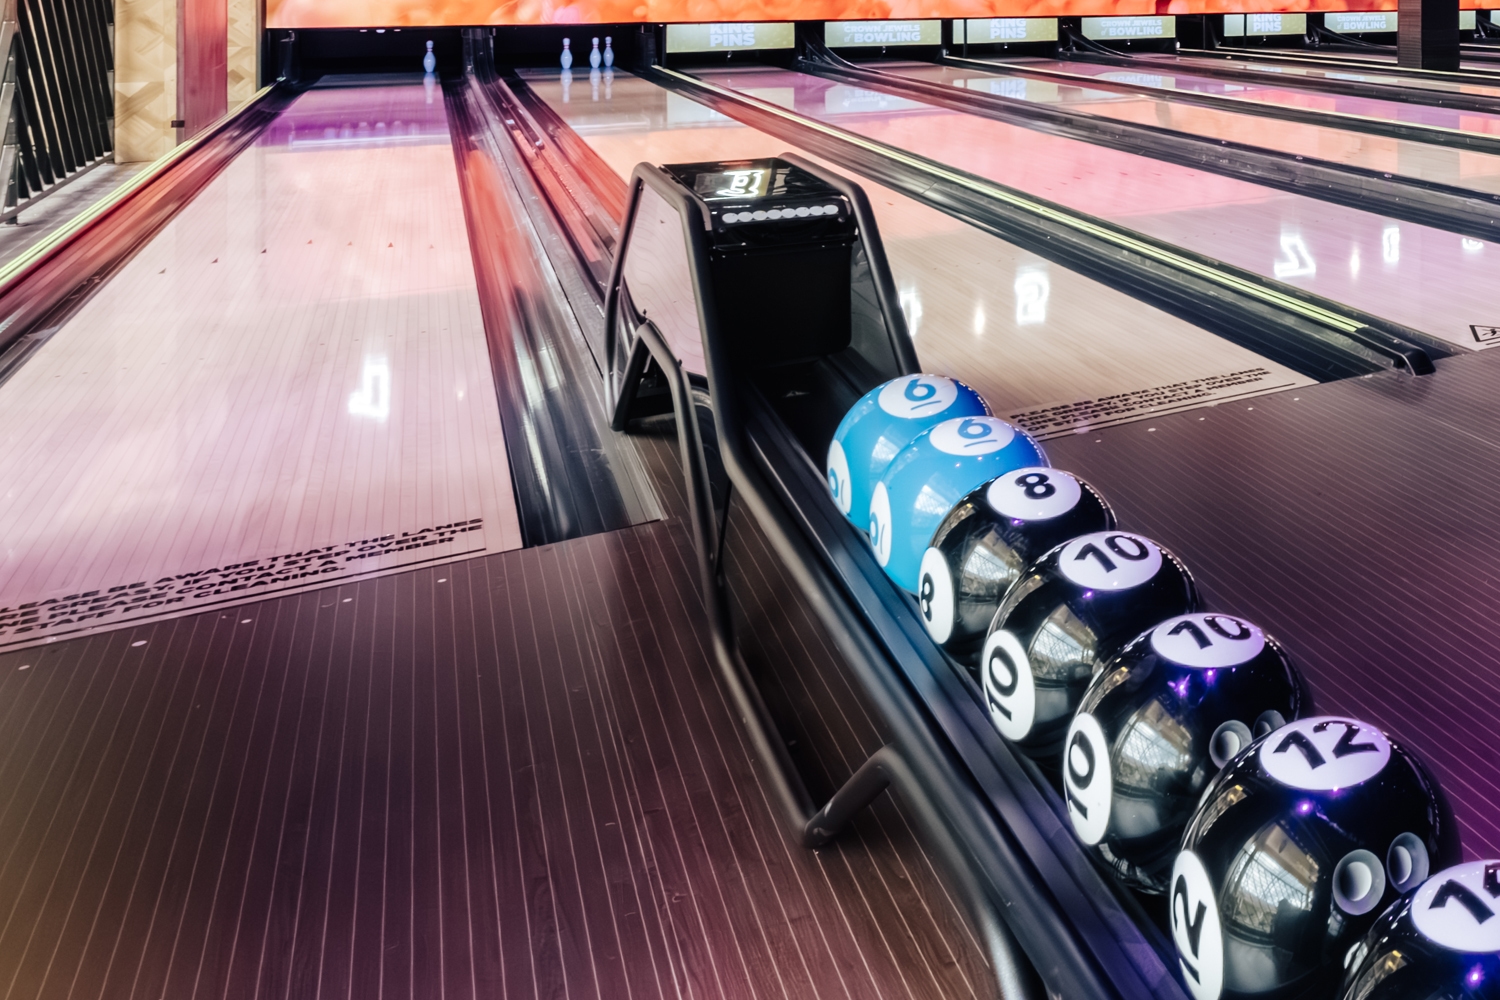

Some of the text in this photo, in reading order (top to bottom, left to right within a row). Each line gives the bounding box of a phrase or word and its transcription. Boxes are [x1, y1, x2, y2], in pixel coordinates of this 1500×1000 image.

[710, 24, 755, 35] KING
[844, 24, 921, 33] CROWN JEWELS
[990, 18, 1026, 28] KING
[990, 27, 1026, 39] PINS
[1101, 19, 1129, 27] CROWN
[1109, 26, 1163, 36] BOWLING
[1253, 14, 1282, 23] KING
[1253, 22, 1282, 32] PINS
[1343, 20, 1386, 30] BOWLING
[710, 33, 755, 47] PINS
[854, 31, 921, 43] BOWLING
[1010, 404, 1072, 419] PLEASE
[1097, 389, 1151, 402] AWARE
[1152, 381, 1189, 391] THAT
[1191, 375, 1220, 383] THE
[1220, 367, 1265, 378] LANES
[1017, 413, 1050, 423] ARE
[1134, 391, 1165, 399] YOU
[1171, 383, 1203, 393] STEP
[1205, 376, 1243, 386] OVER
[1244, 370, 1272, 378] THE
[1020, 418, 1058, 428] LINE
[1060, 405, 1120, 420] PLEASE
[1120, 390, 1189, 408] CONTACT
[1207, 377, 1264, 391] MEMBER
[1027, 424, 1050, 432] OF
[1052, 413, 1103, 427] STAFF
[1104, 407, 1136, 416] FOR
[1015, 473, 1056, 500] 8
[0, 518, 483, 613] LEASE BE AWARE THAT THE LANES
[1073, 534, 1150, 574] 10
[0, 608, 39, 622] RE
[184, 576, 210, 586] IF
[219, 563, 277, 580] YOU
[283, 550, 350, 567] STEP
[357, 535, 428, 552] OVER
[433, 524, 483, 537] THE
[48, 592, 168, 620] PLEASE
[176, 564, 313, 595] CONTACT
[317, 558, 340, 567] A
[345, 537, 455, 562] MEMBER
[13, 566, 346, 635] STAFF FOR CLEANING.
[921, 572, 935, 622] 8
[1167, 615, 1252, 649] 10
[986, 645, 1018, 722] 10
[1272, 720, 1380, 770] 12
[1065, 730, 1096, 820] 10
[1173, 873, 1208, 985] 12
